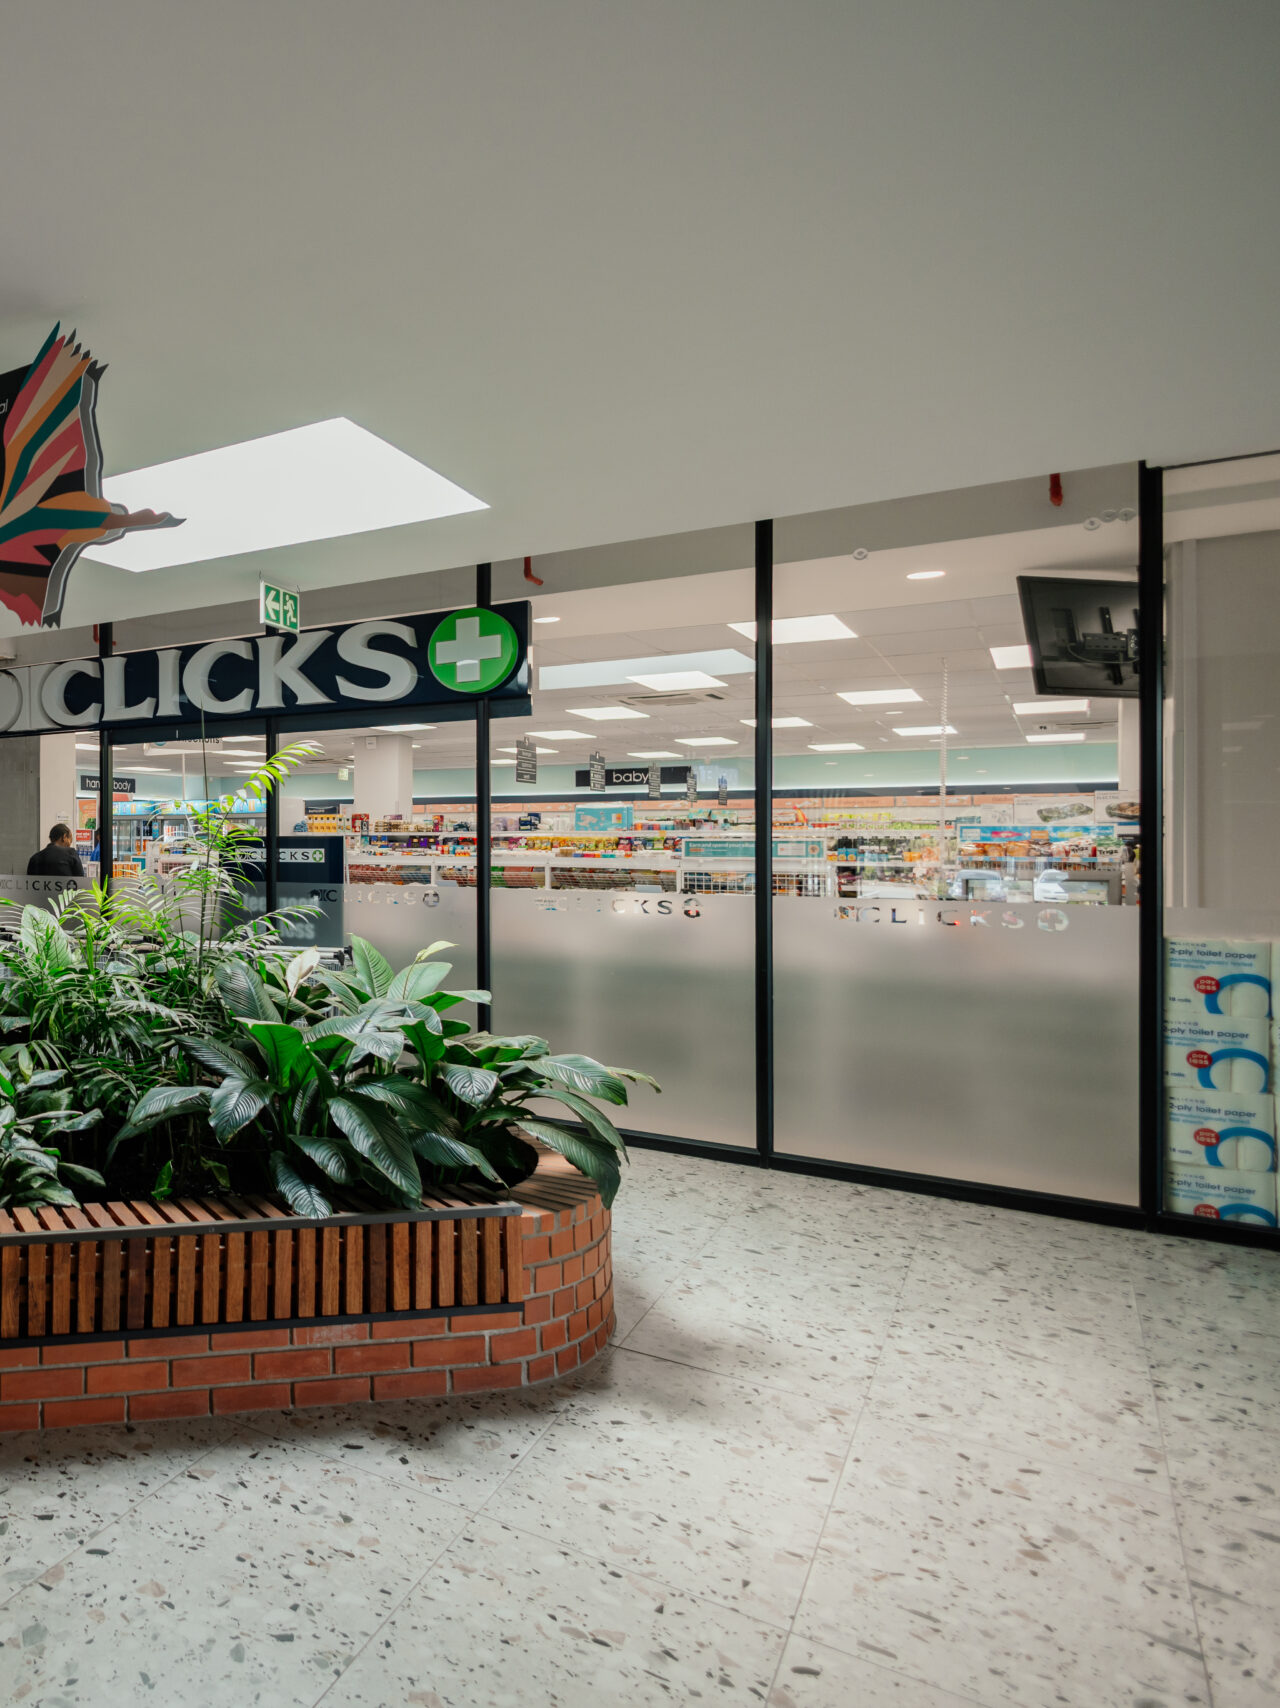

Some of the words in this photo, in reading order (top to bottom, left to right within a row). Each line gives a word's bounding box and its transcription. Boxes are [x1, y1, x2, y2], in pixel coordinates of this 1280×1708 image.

[41, 620, 419, 726] CLICKS
[612, 770, 649, 784] baby
[86, 778, 101, 788] han
[113, 781, 131, 792] body
[248, 851, 310, 861] CLCKS
[7, 879, 63, 891] CLICKS
[858, 906, 1024, 928] CLICKS
[1169, 947, 1193, 956] 2-ply
[1196, 949, 1222, 957] toilet
[1224, 952, 1256, 960] paper
[1189, 1027, 1214, 1036] toilet
[1217, 1031, 1249, 1039] paper
[1195, 1105, 1221, 1114] toilet
[1224, 1109, 1257, 1118] paper
[1195, 1181, 1221, 1190] toilet
[1223, 1185, 1256, 1195] paper
